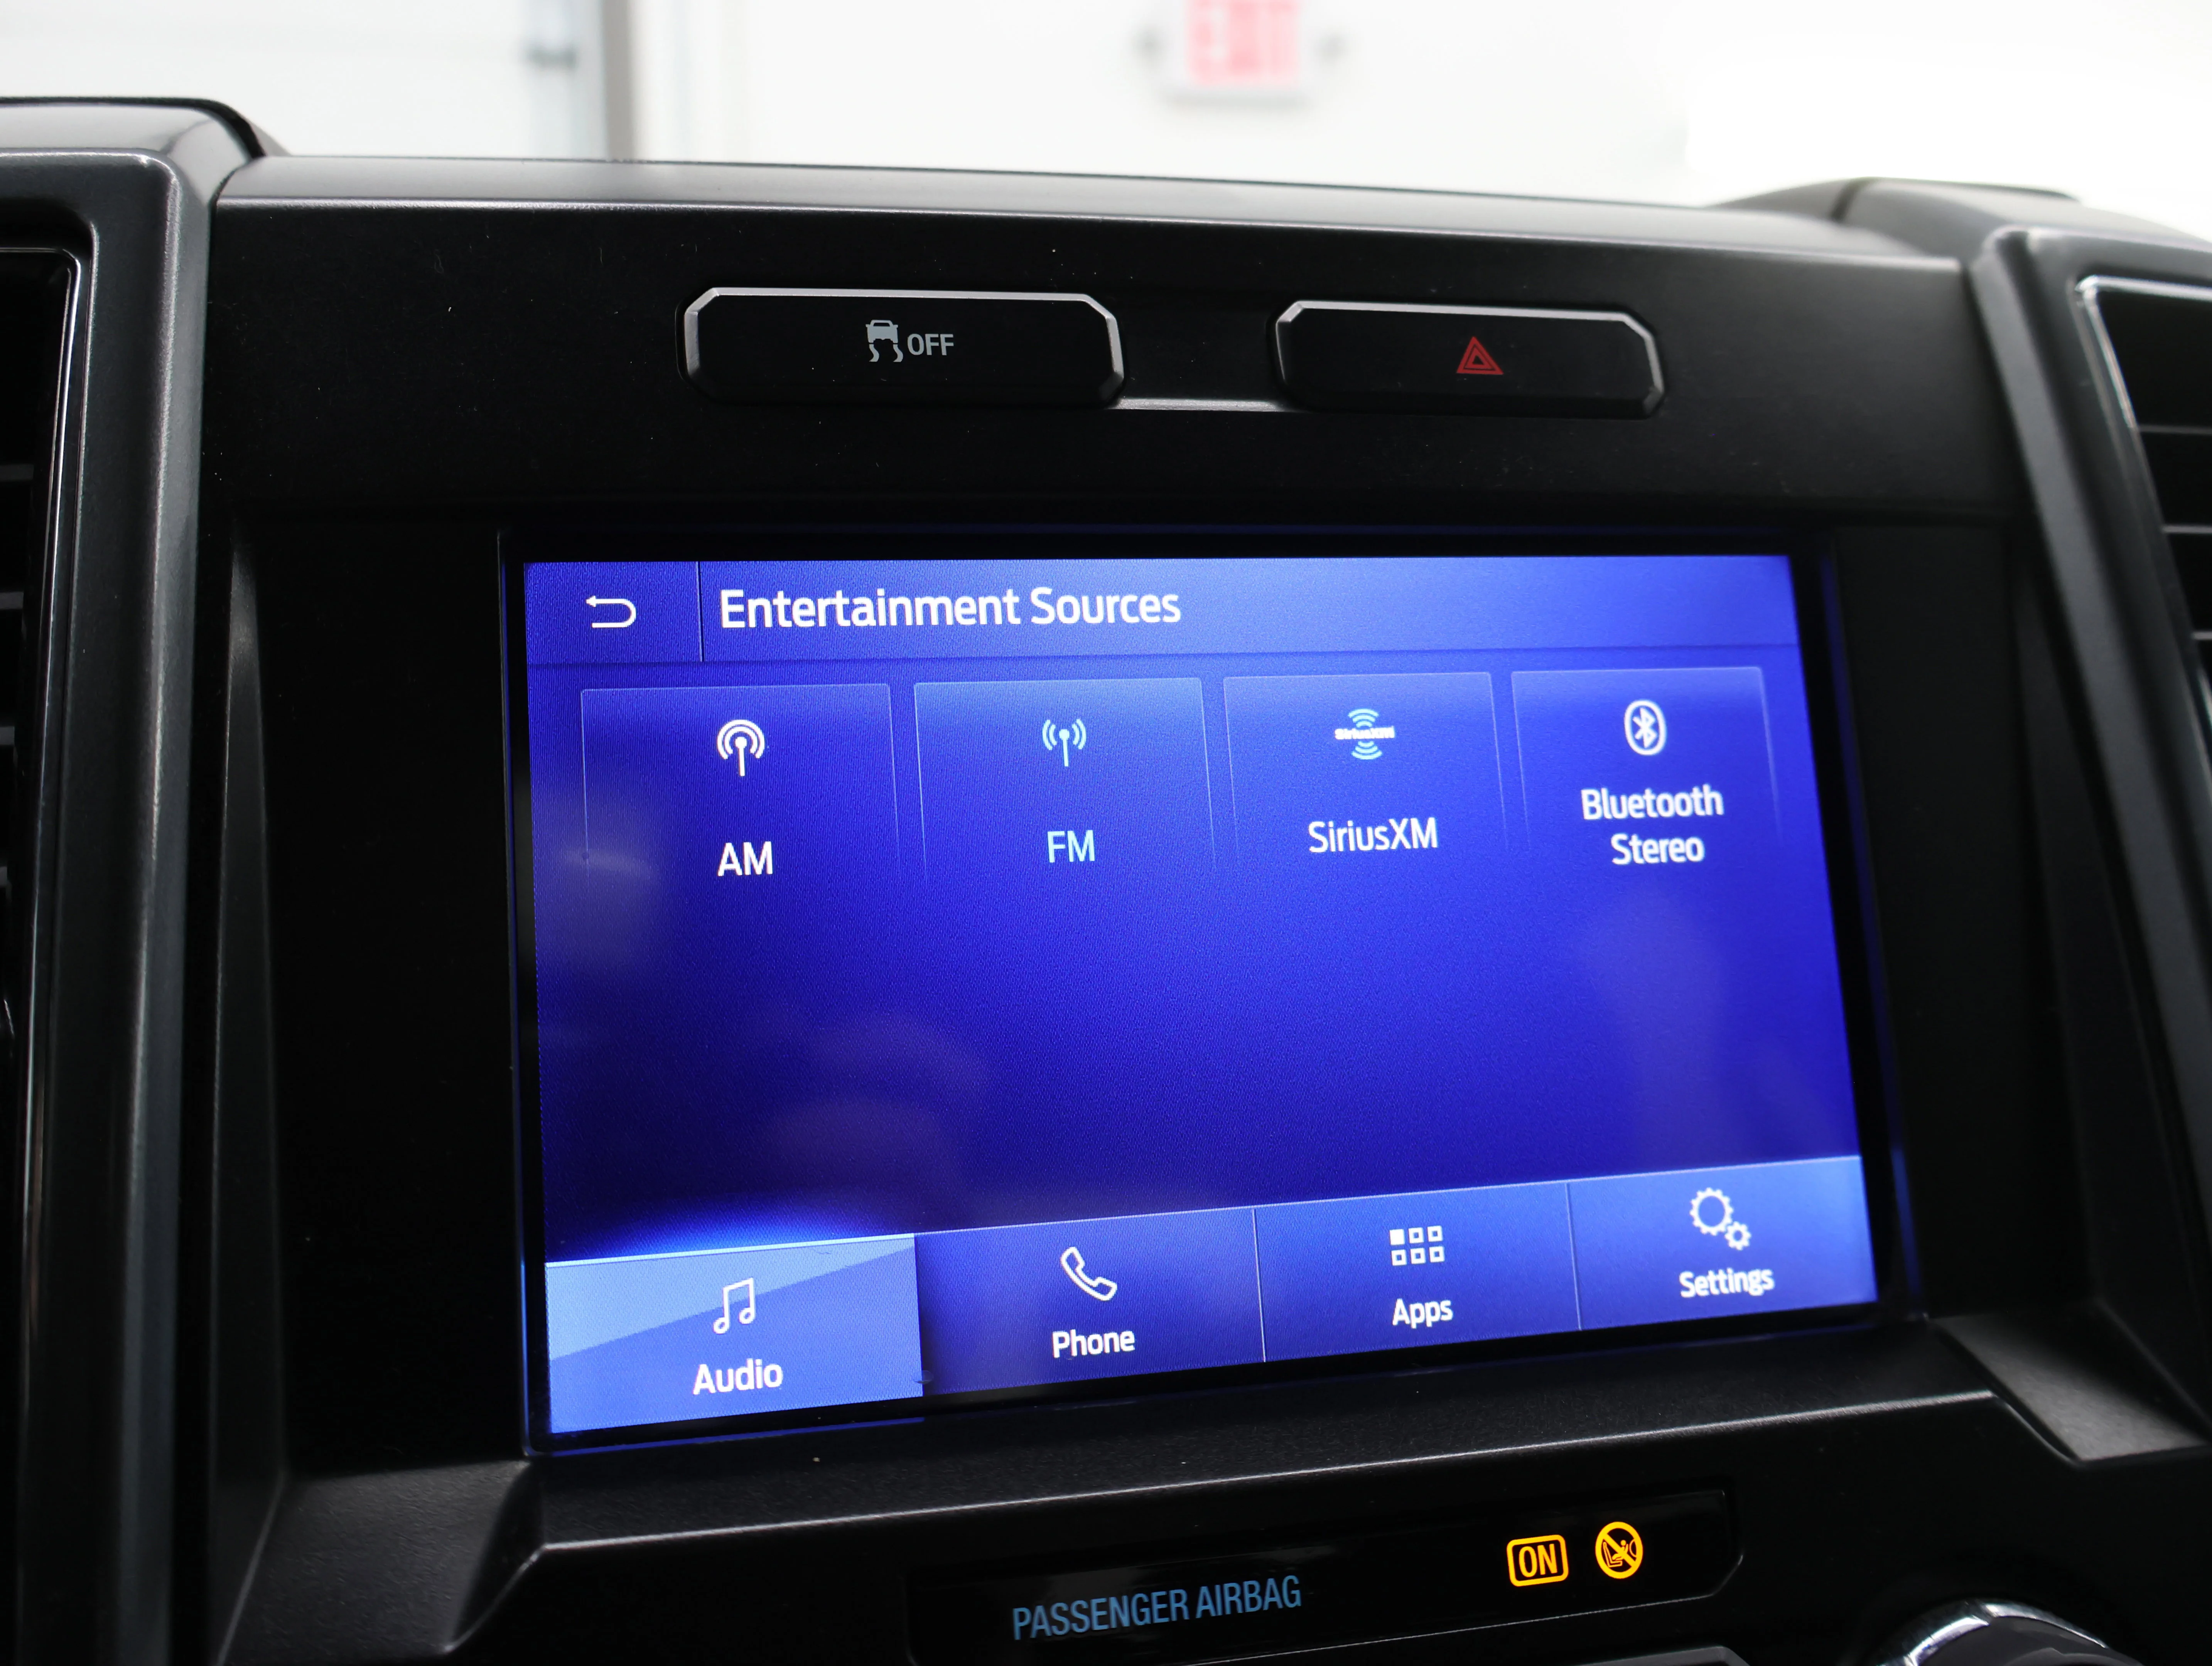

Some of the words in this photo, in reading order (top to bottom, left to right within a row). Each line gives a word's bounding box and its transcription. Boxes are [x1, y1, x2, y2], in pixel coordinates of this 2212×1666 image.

[907, 334, 954, 356] OFF
[720, 588, 1021, 628] Entertainment
[1031, 587, 1181, 625] Sources
[1581, 784, 1724, 820] Bluetooth
[1047, 829, 1095, 863] FM
[1308, 816, 1438, 853] SiriusXM
[1610, 833, 1705, 865] Stereo
[717, 841, 773, 877] AM
[1679, 1267, 1775, 1299] Settings
[1392, 1298, 1454, 1329] Apps
[1052, 1329, 1136, 1359] Phone
[693, 1357, 784, 1395] Audio
[1519, 1543, 1557, 1577] ON
[1013, 1588, 1190, 1640] PASSENGER
[1196, 1575, 1301, 1619] AIRBAG
